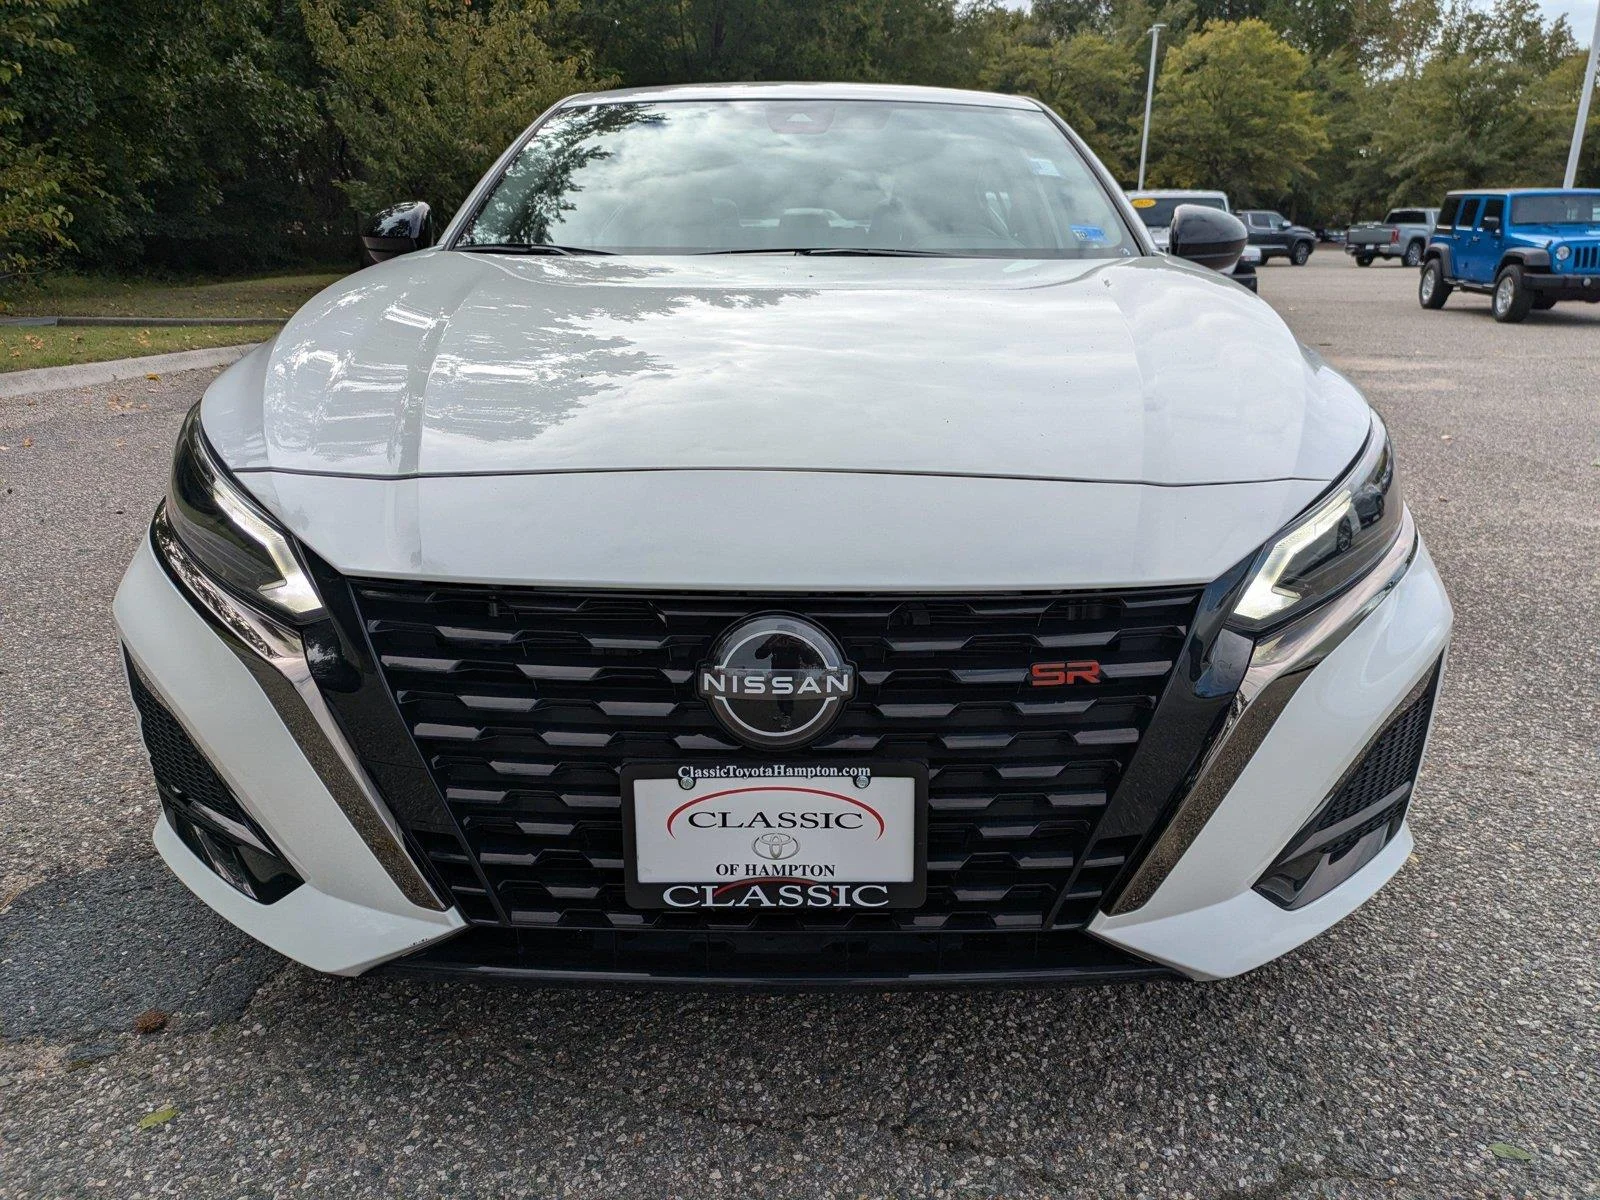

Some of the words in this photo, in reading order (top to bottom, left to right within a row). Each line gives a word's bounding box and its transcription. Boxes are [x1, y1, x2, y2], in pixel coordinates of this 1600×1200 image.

[703, 672, 849, 694] NISSAN
[1032, 660, 1101, 686] SR
[677, 764, 871, 779] ClassicToyotaHampton.com
[688, 811, 864, 830] CLASSIC
[715, 863, 740, 877] OF
[744, 863, 836, 877] HAMPTON
[662, 885, 889, 907] CLASSIC
